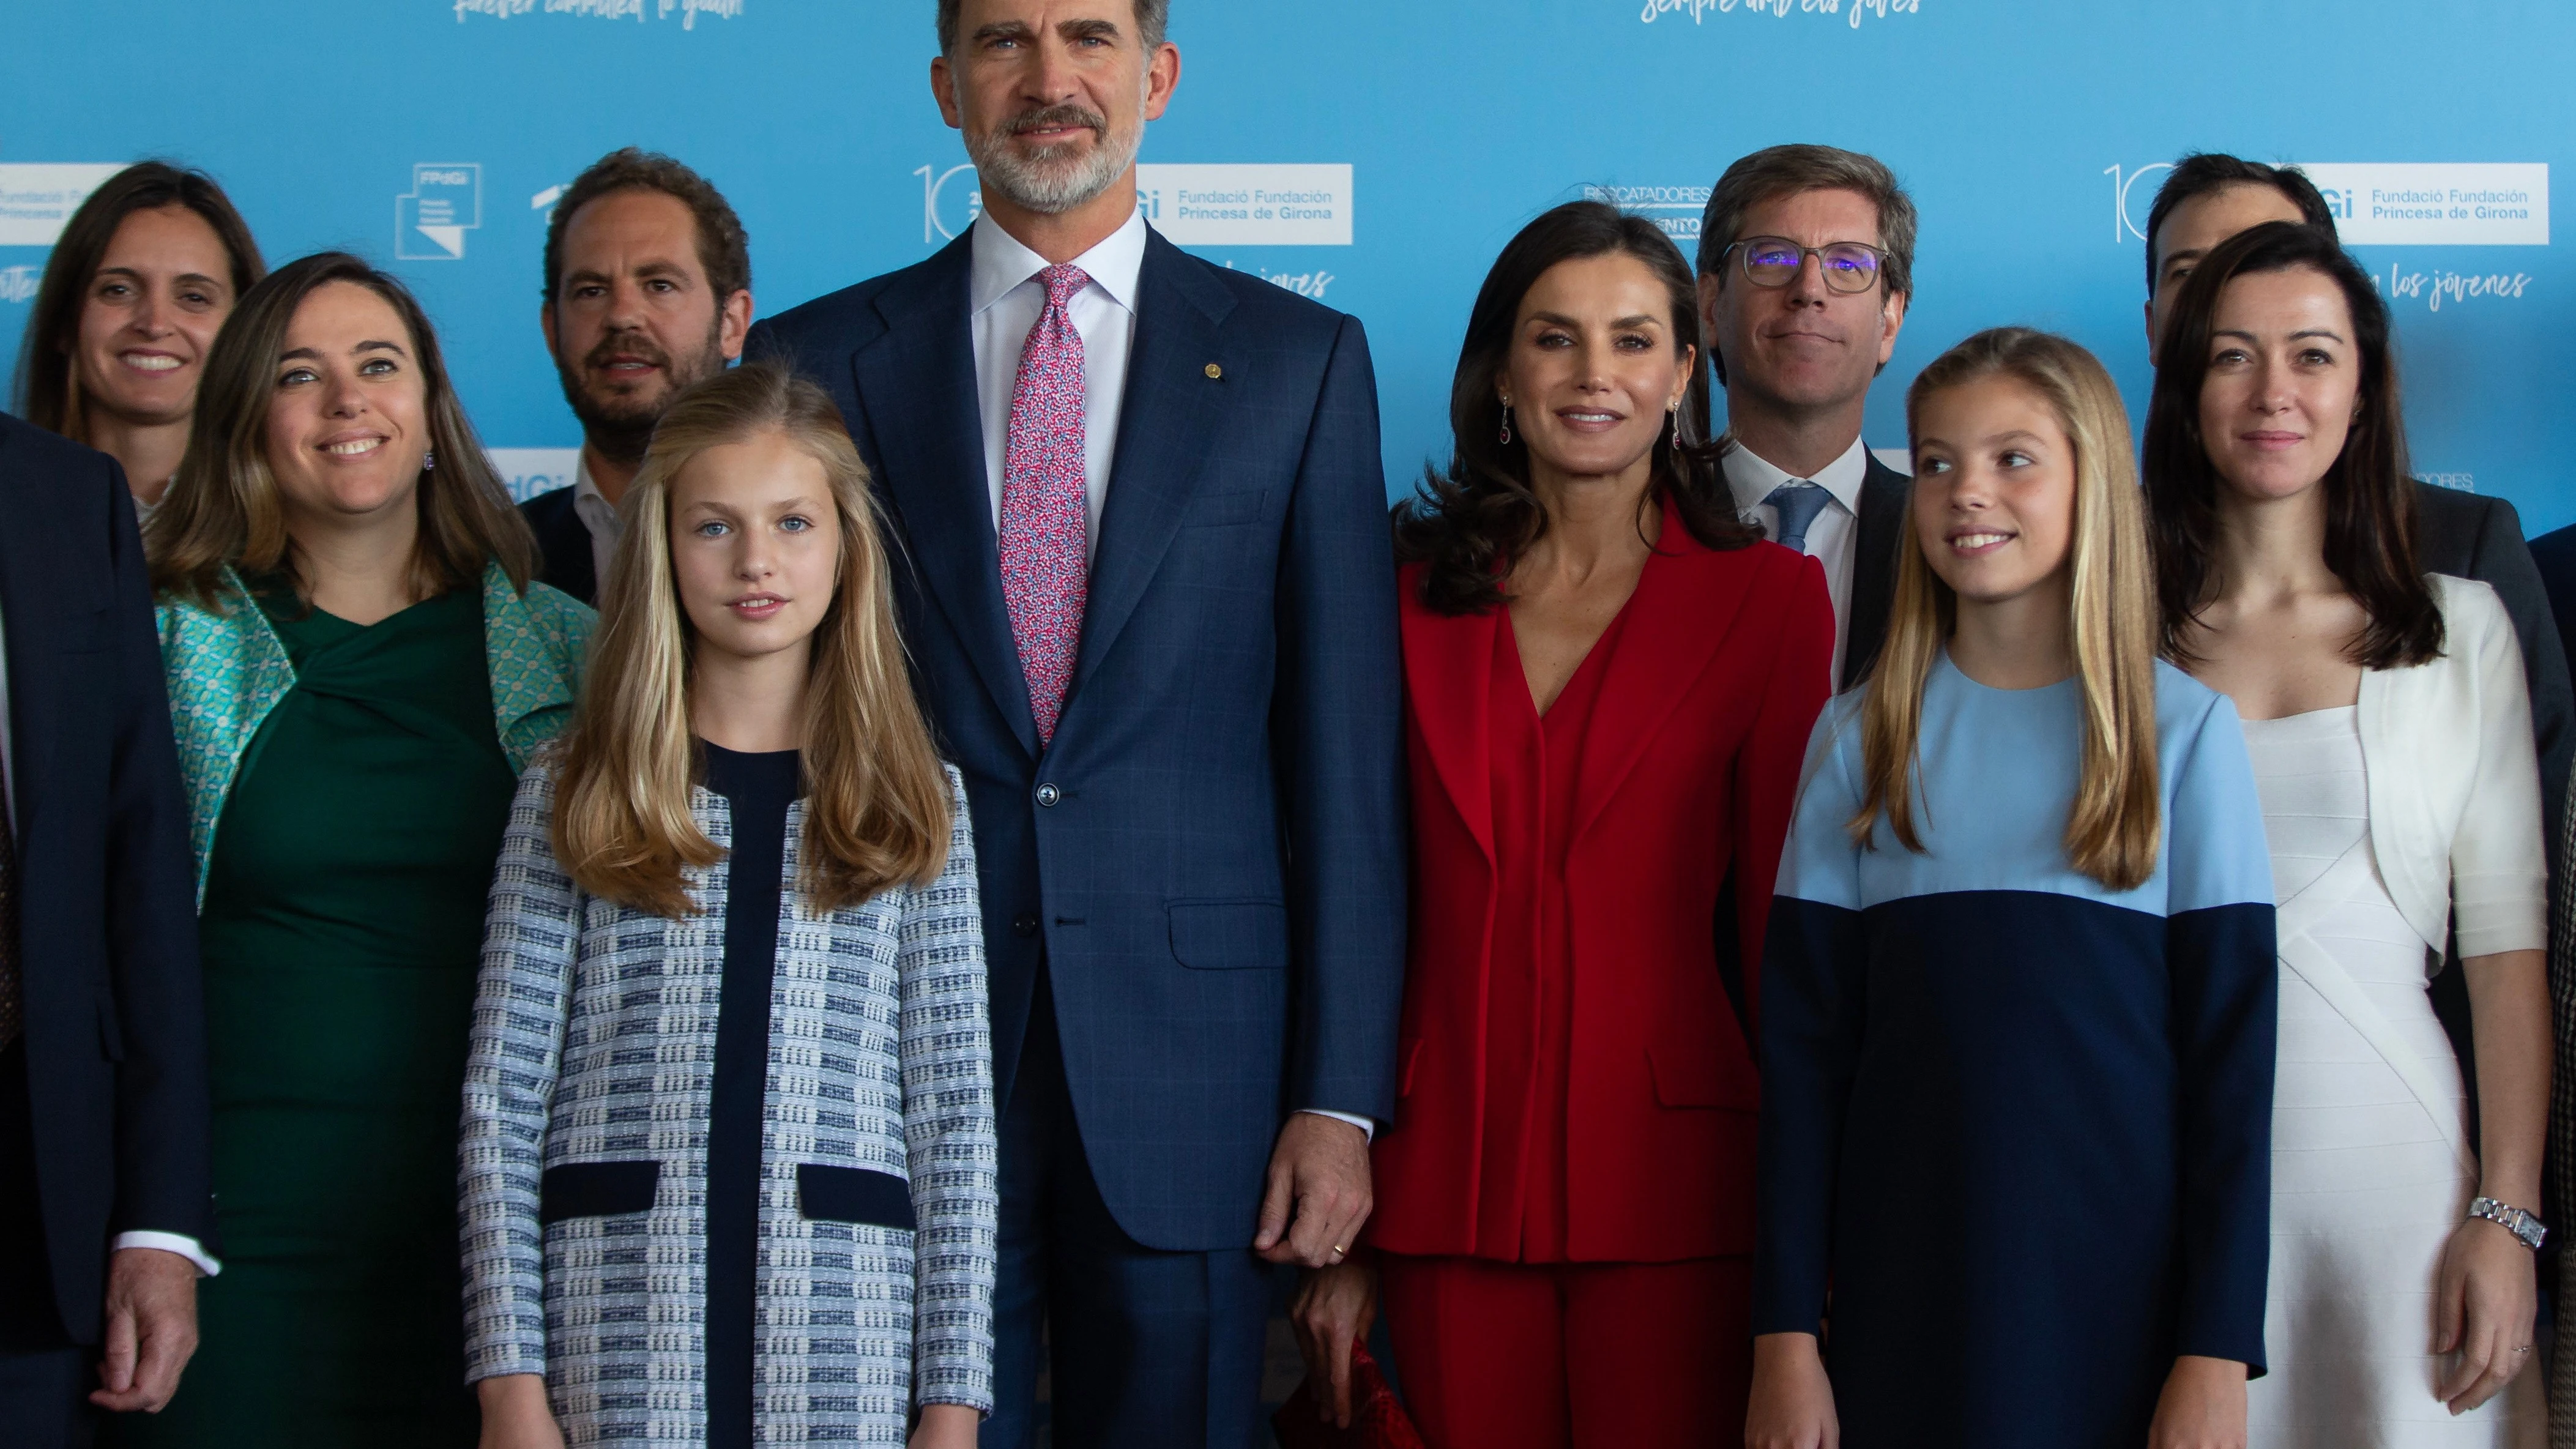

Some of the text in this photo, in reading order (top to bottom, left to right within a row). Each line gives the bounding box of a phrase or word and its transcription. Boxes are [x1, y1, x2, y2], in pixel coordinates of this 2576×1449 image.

[1177, 190, 1333, 204] Fundació Fundación
[2372, 188, 2529, 203] Fundació Fundación
[1178, 206, 1333, 220] Princesa de Girona
[2372, 206, 2529, 220] Princesa de Girona
[2391, 263, 2429, 299] los
[2429, 269, 2533, 313] jóvenes
